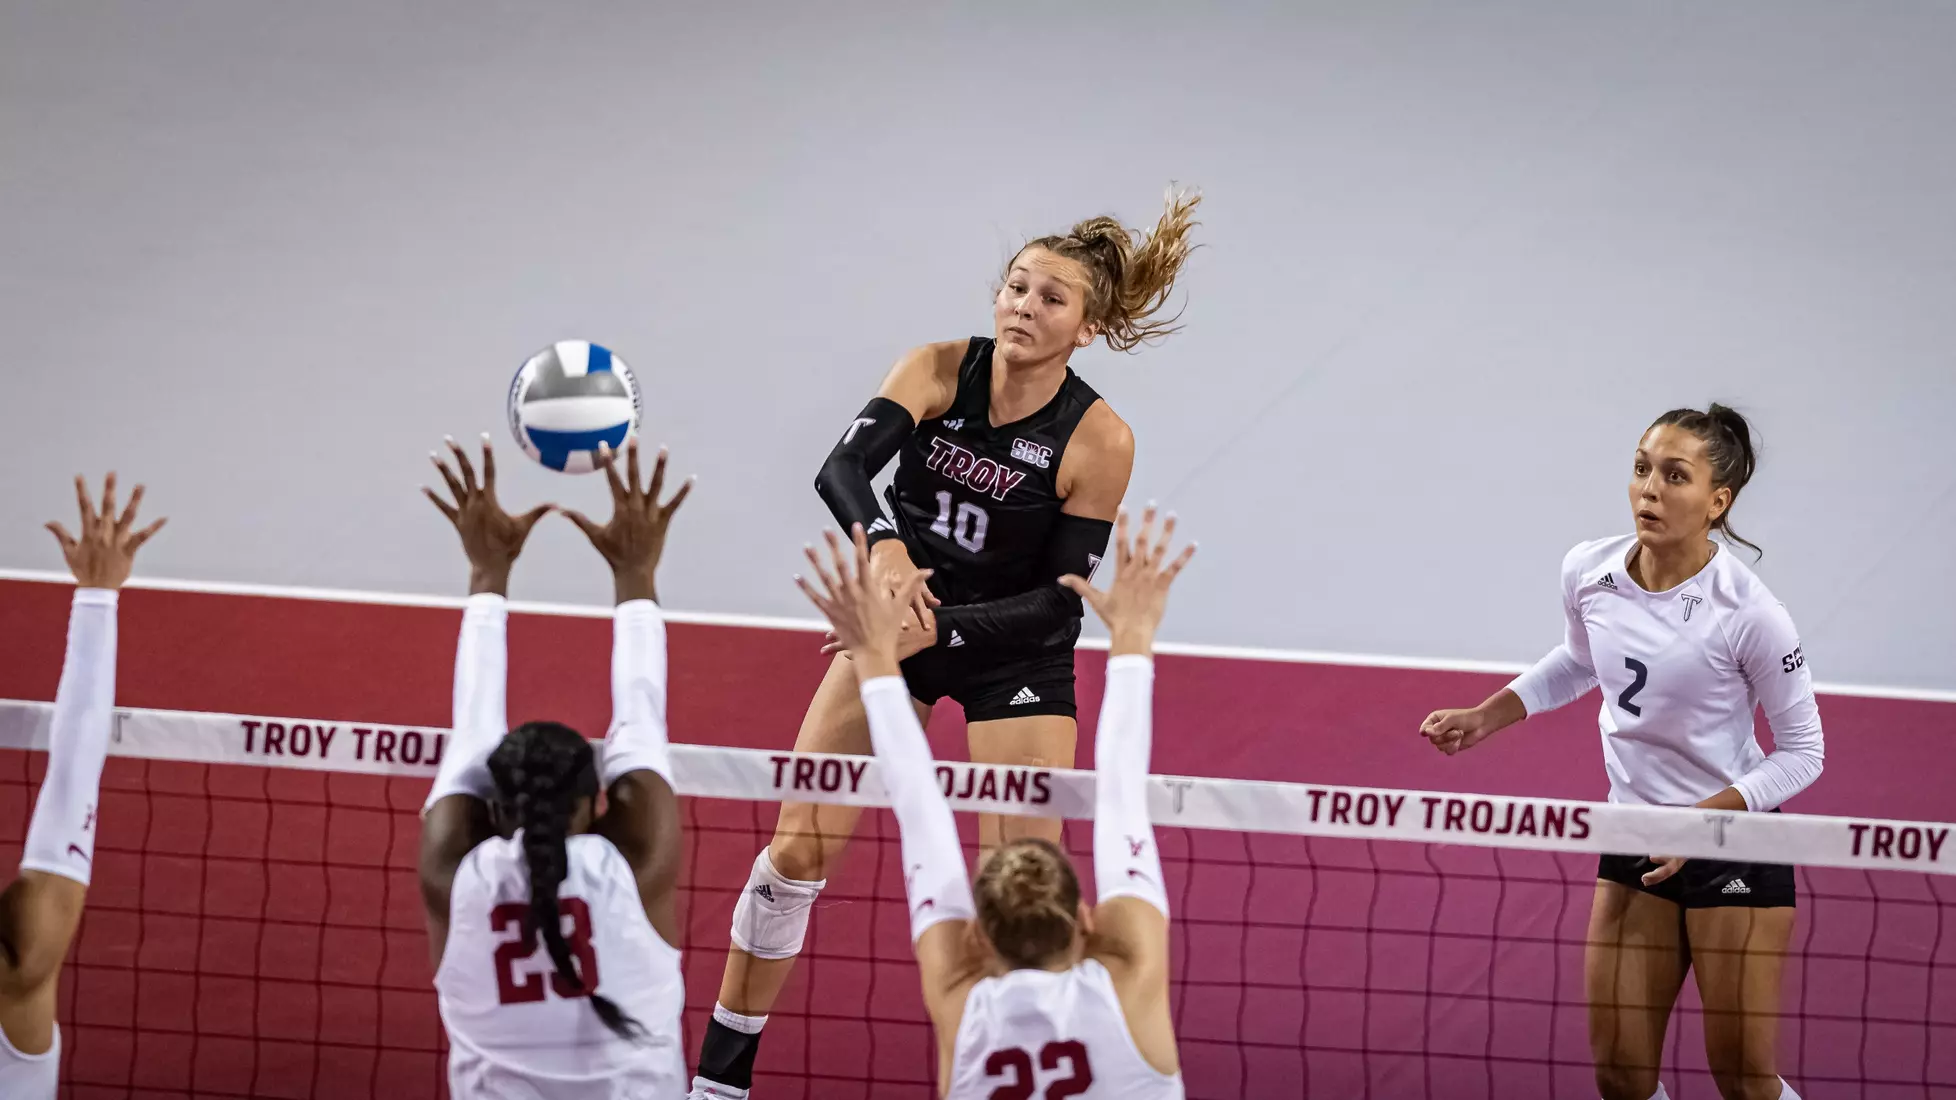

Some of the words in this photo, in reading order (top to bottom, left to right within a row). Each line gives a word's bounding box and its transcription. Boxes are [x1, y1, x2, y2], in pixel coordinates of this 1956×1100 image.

[926, 436, 1026, 501] TROY
[1011, 438, 1053, 468] SBC
[930, 490, 989, 553] 10
[1597, 580, 1618, 591] adidas
[1782, 642, 1805, 673] SB
[1009, 695, 1041, 705] adidas
[1617, 657, 1648, 718] 2
[241, 720, 337, 758] TROY
[352, 728, 446, 766] TROJ
[770, 756, 868, 793] TROY
[936, 766, 1052, 804] OJANS
[1306, 790, 1407, 827] TROY
[1421, 798, 1591, 840] TROJANS
[1848, 824, 1949, 862] TROY
[1722, 886, 1751, 894] adidas
[985, 1039, 1093, 1100] 22
